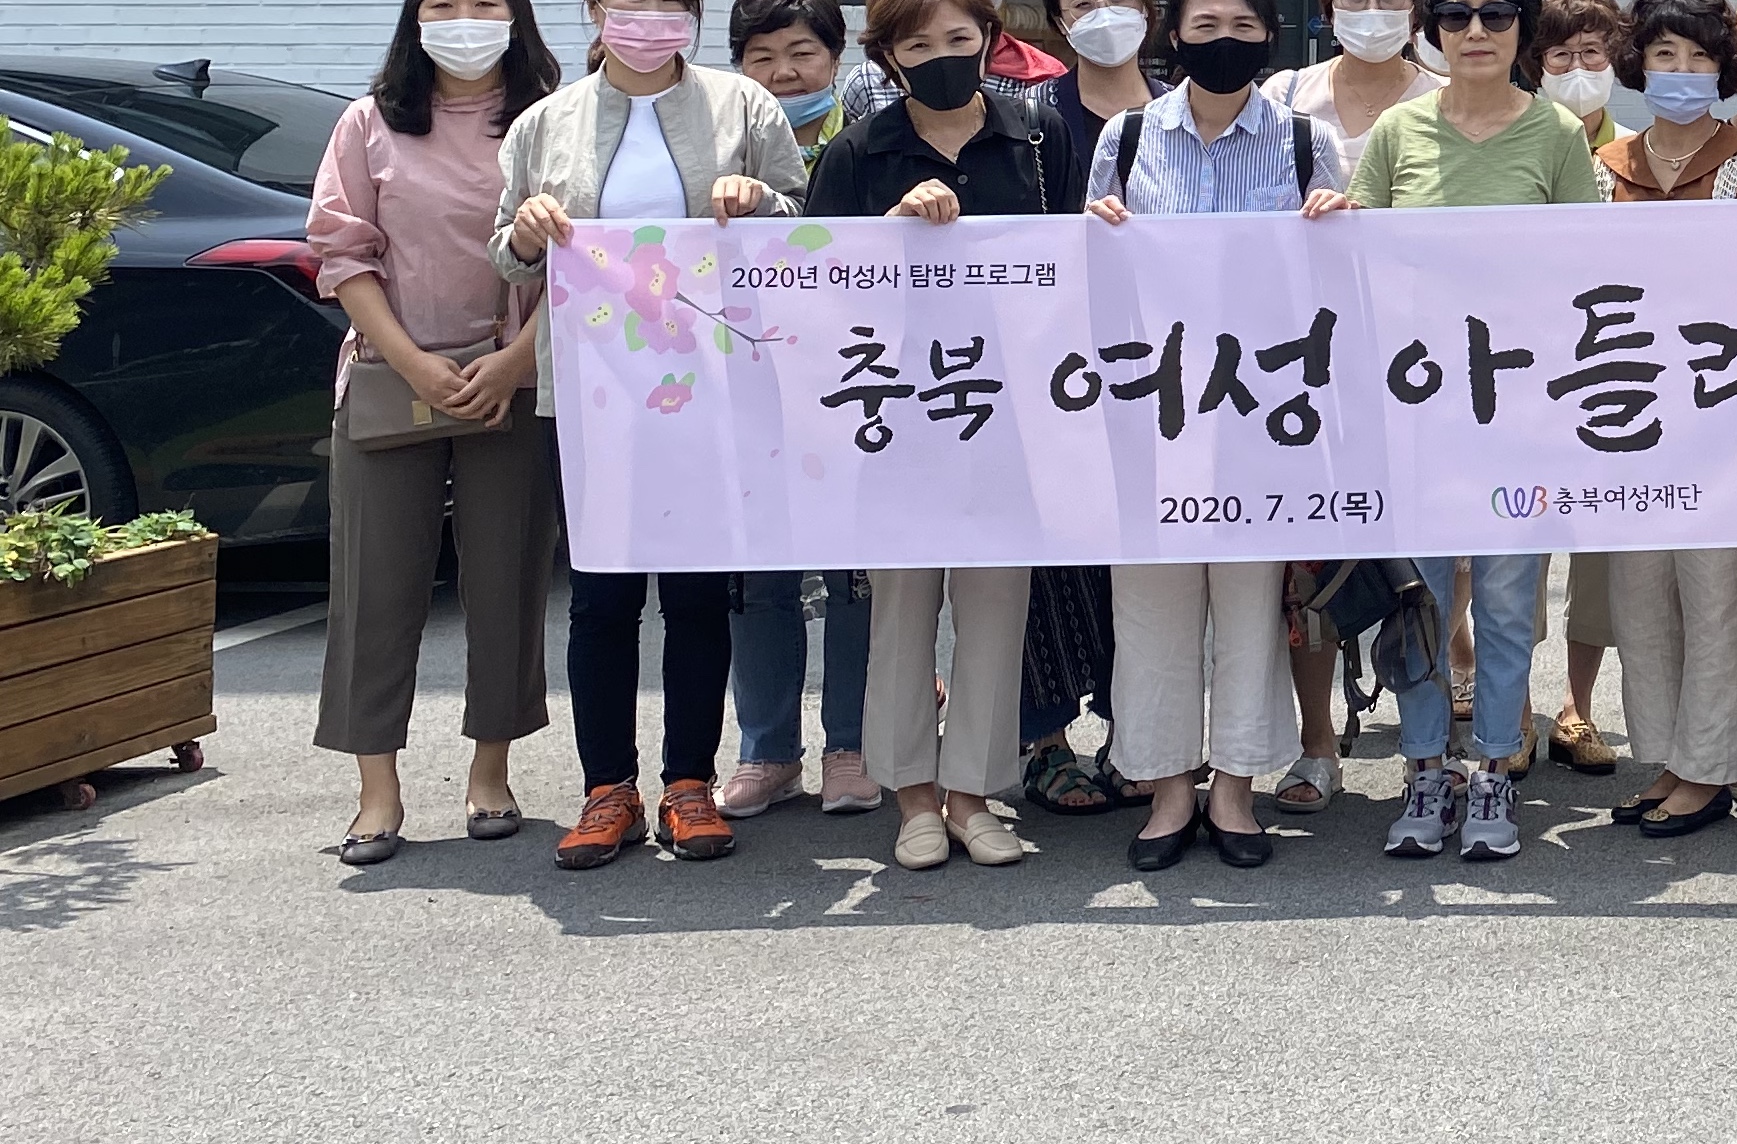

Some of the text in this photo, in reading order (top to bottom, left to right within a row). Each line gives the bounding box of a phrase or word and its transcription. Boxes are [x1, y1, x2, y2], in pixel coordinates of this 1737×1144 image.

[731, 262, 1057, 290] 2020년 여성사 탐방 프로그램
[819, 326, 1004, 454] 충북
[1049, 307, 1338, 447] 여성
[1160, 489, 1384, 524] 2020. 7. 2(목)
[1552, 483, 1703, 515] 충북여성재단
